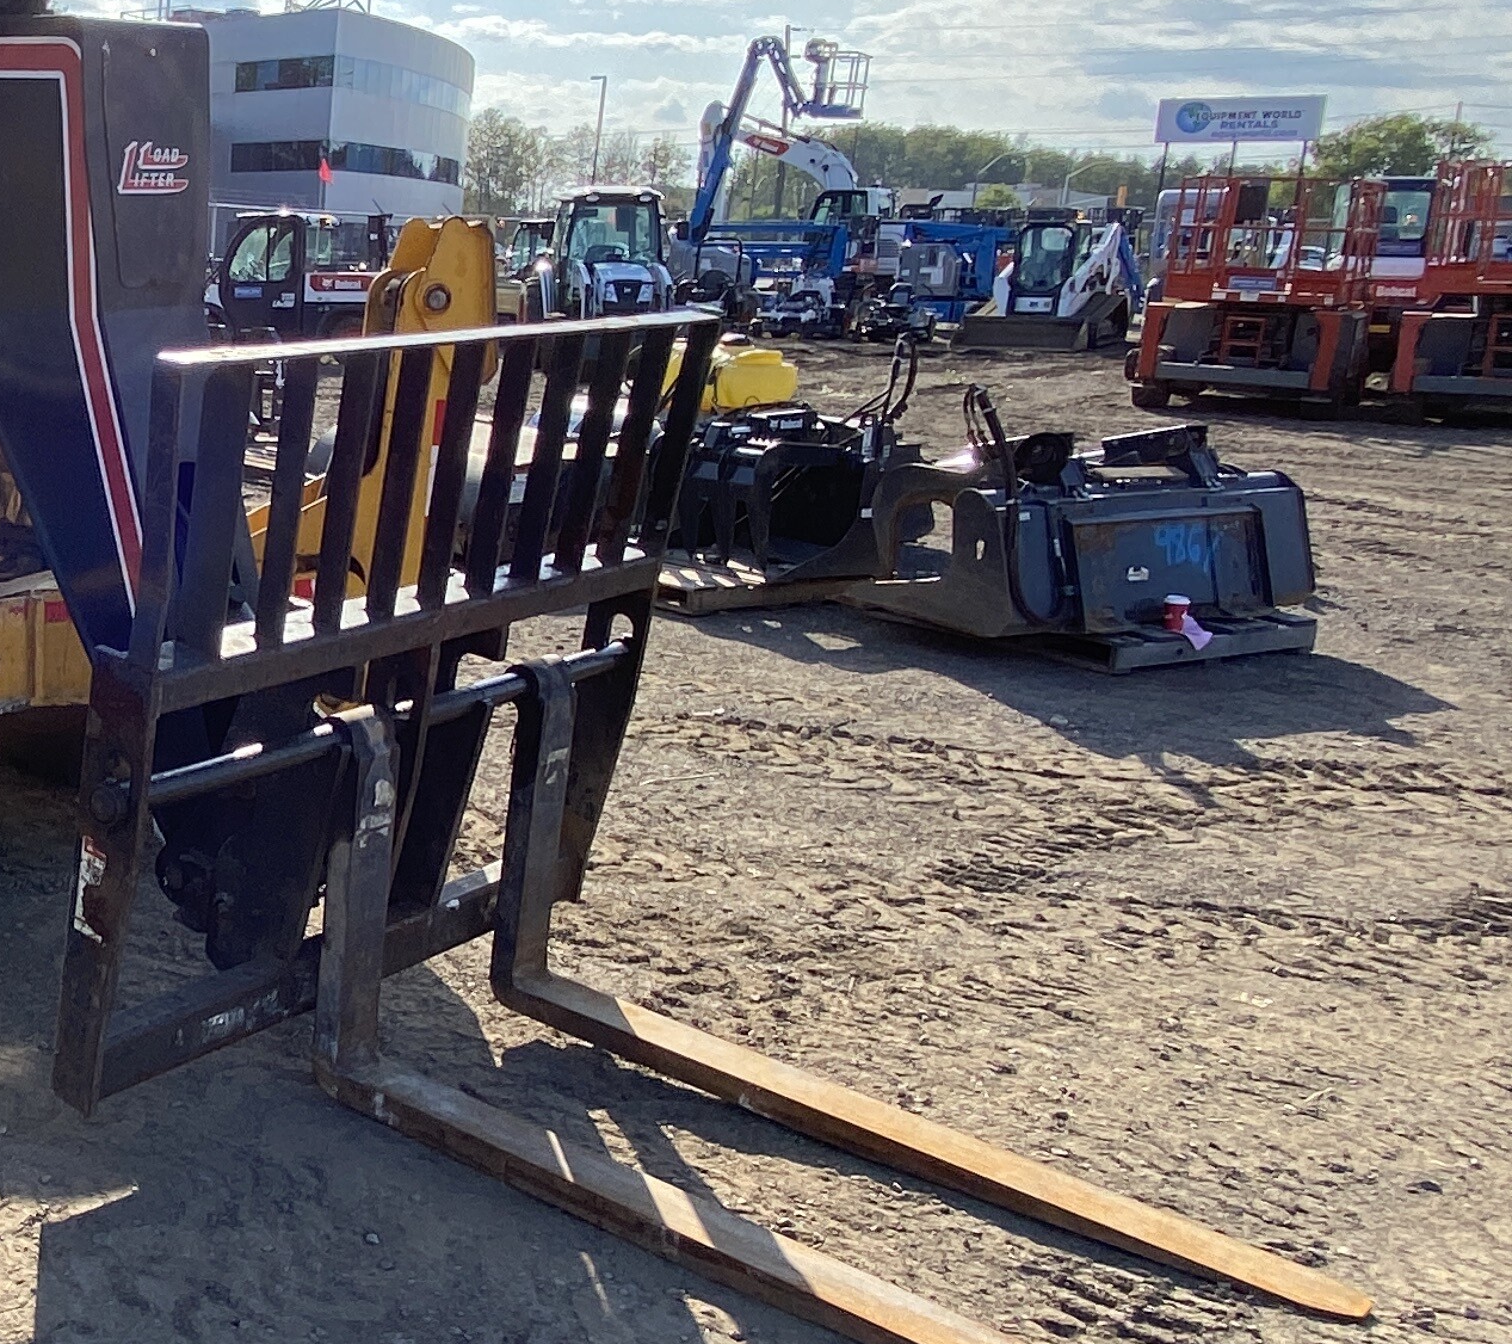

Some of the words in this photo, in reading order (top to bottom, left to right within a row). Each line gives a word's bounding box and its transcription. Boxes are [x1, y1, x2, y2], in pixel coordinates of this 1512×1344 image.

[1220, 119, 1279, 130] RENTALS
[1262, 109, 1302, 120] WORLD
[137, 141, 189, 170] LOAD
[117, 141, 189, 194] LIFTER
